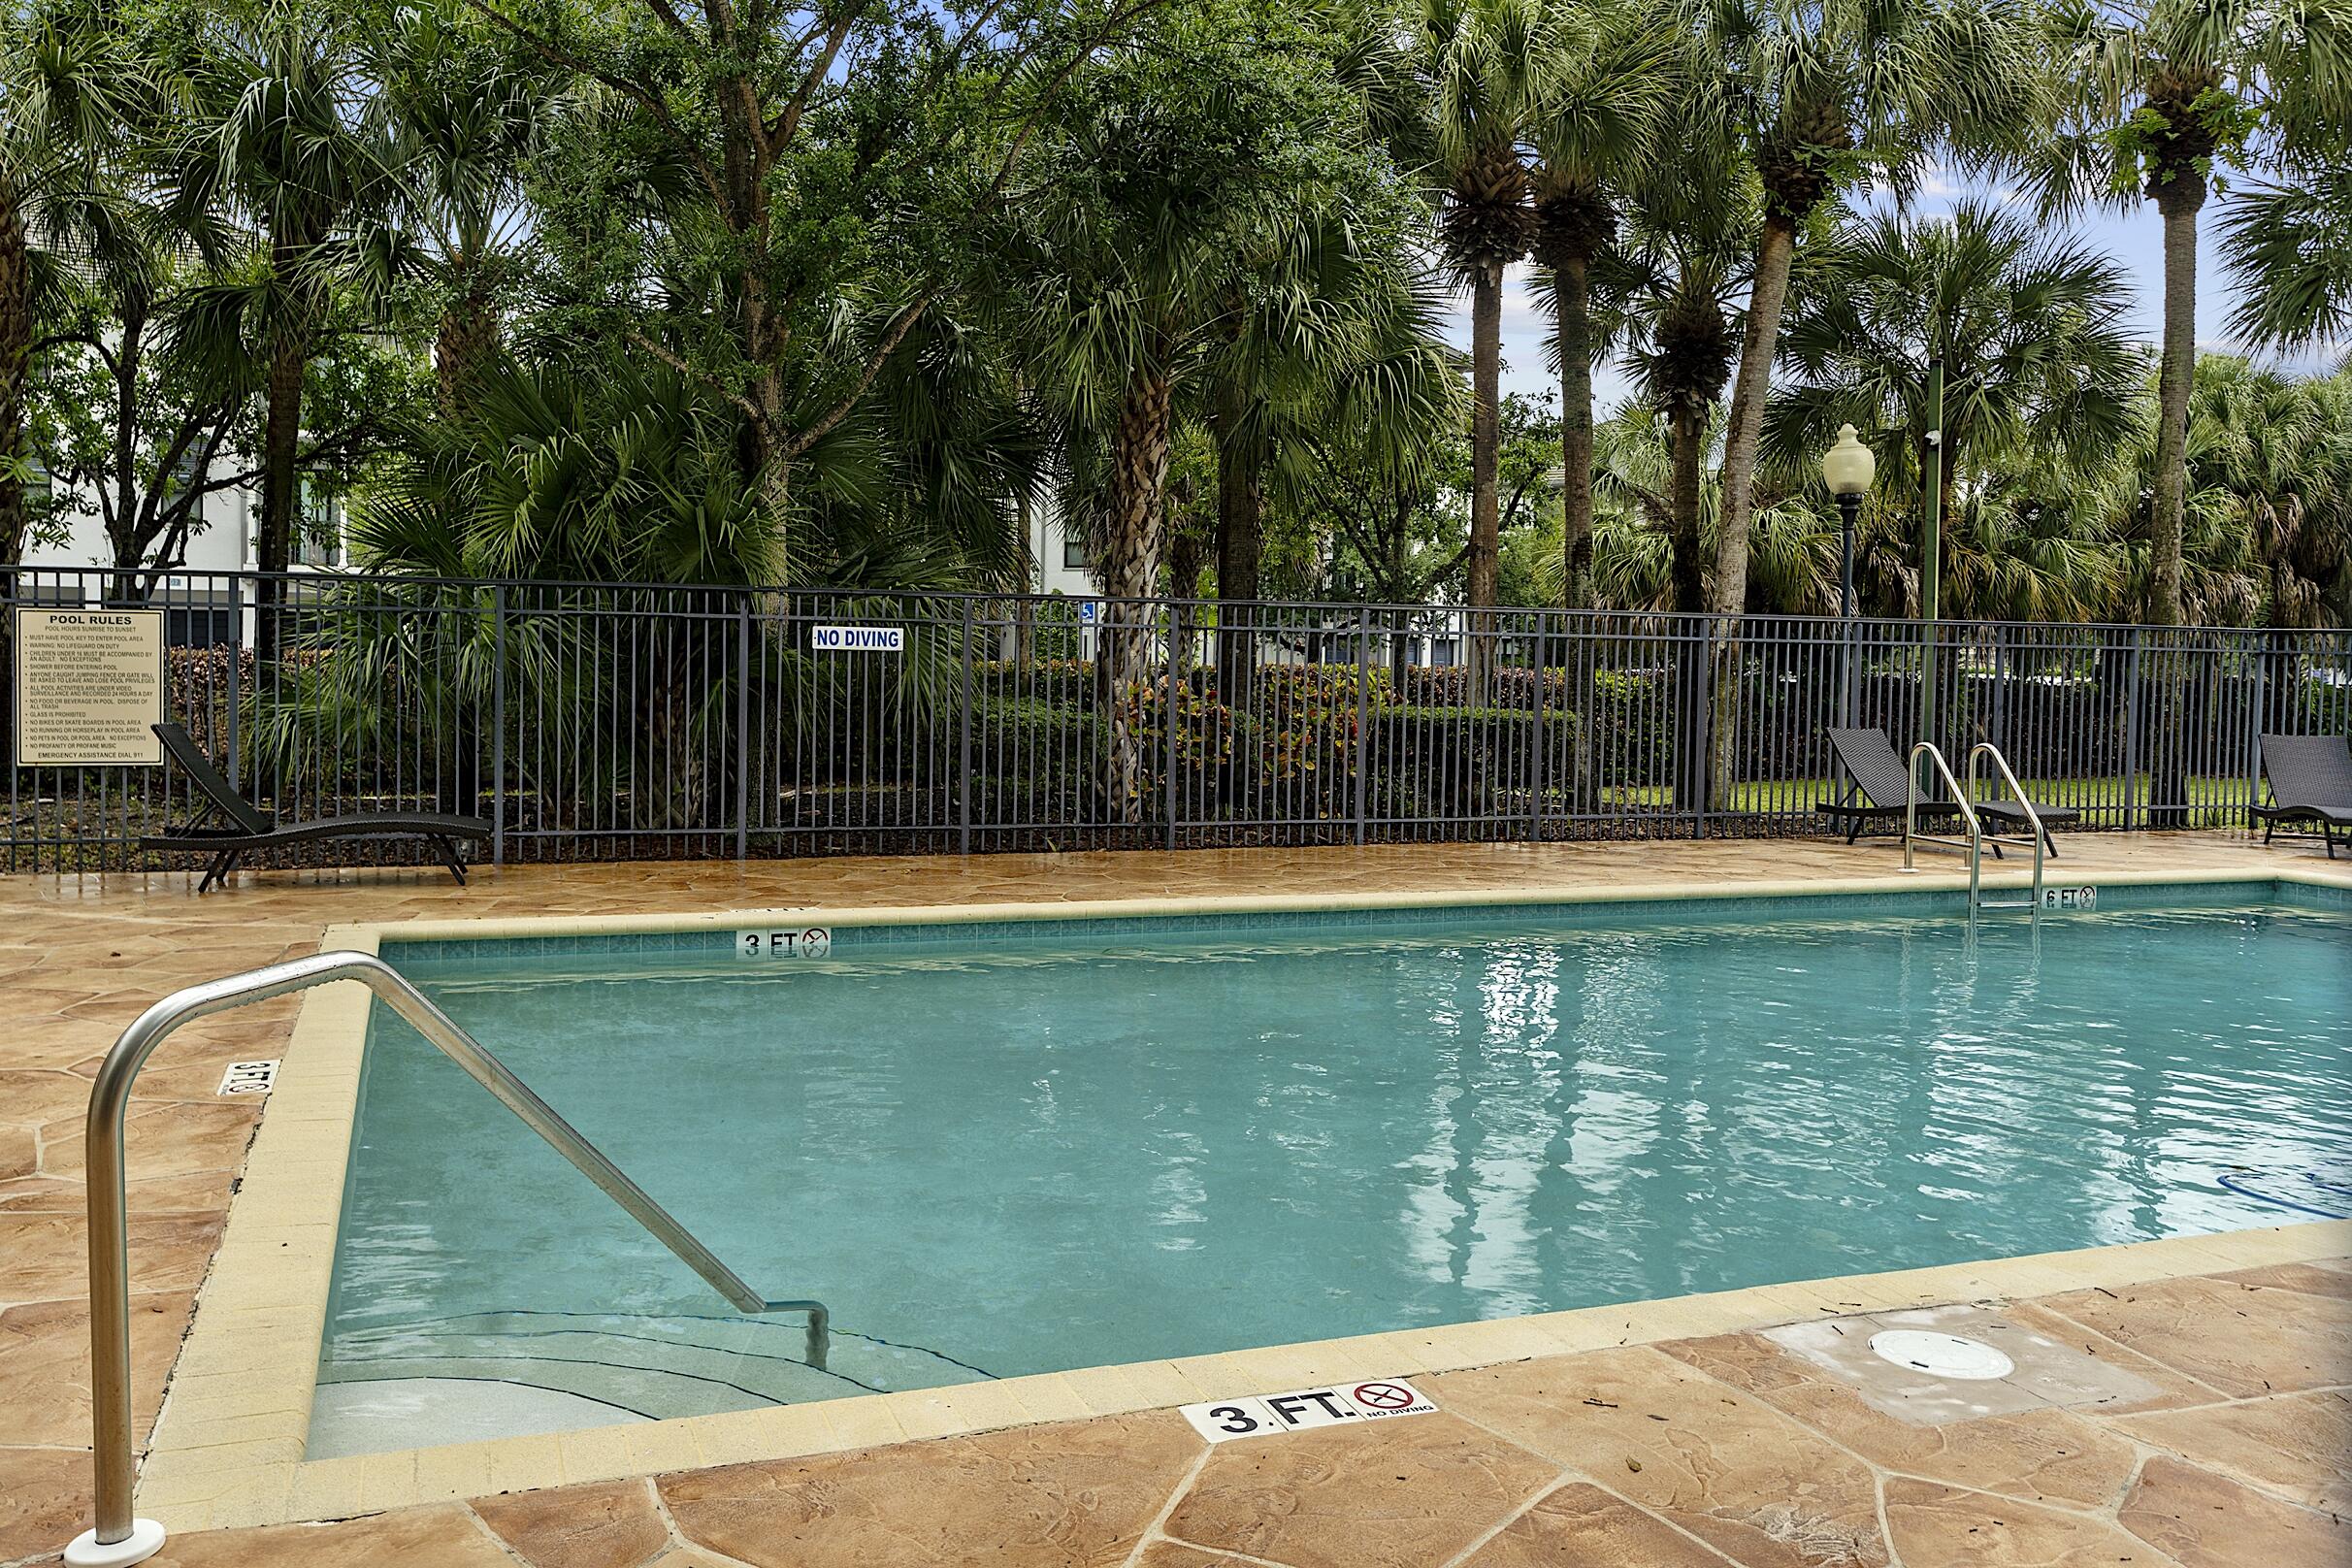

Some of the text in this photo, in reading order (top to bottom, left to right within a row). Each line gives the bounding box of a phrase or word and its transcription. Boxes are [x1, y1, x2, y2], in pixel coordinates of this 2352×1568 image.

[50, 615, 132, 625] POOL RULES
[817, 630, 898, 647] NO DIVING
[2047, 889, 2077, 903] 6 FT
[746, 933, 797, 947] 3 FT
[1389, 1405, 1434, 1414] DIVING
